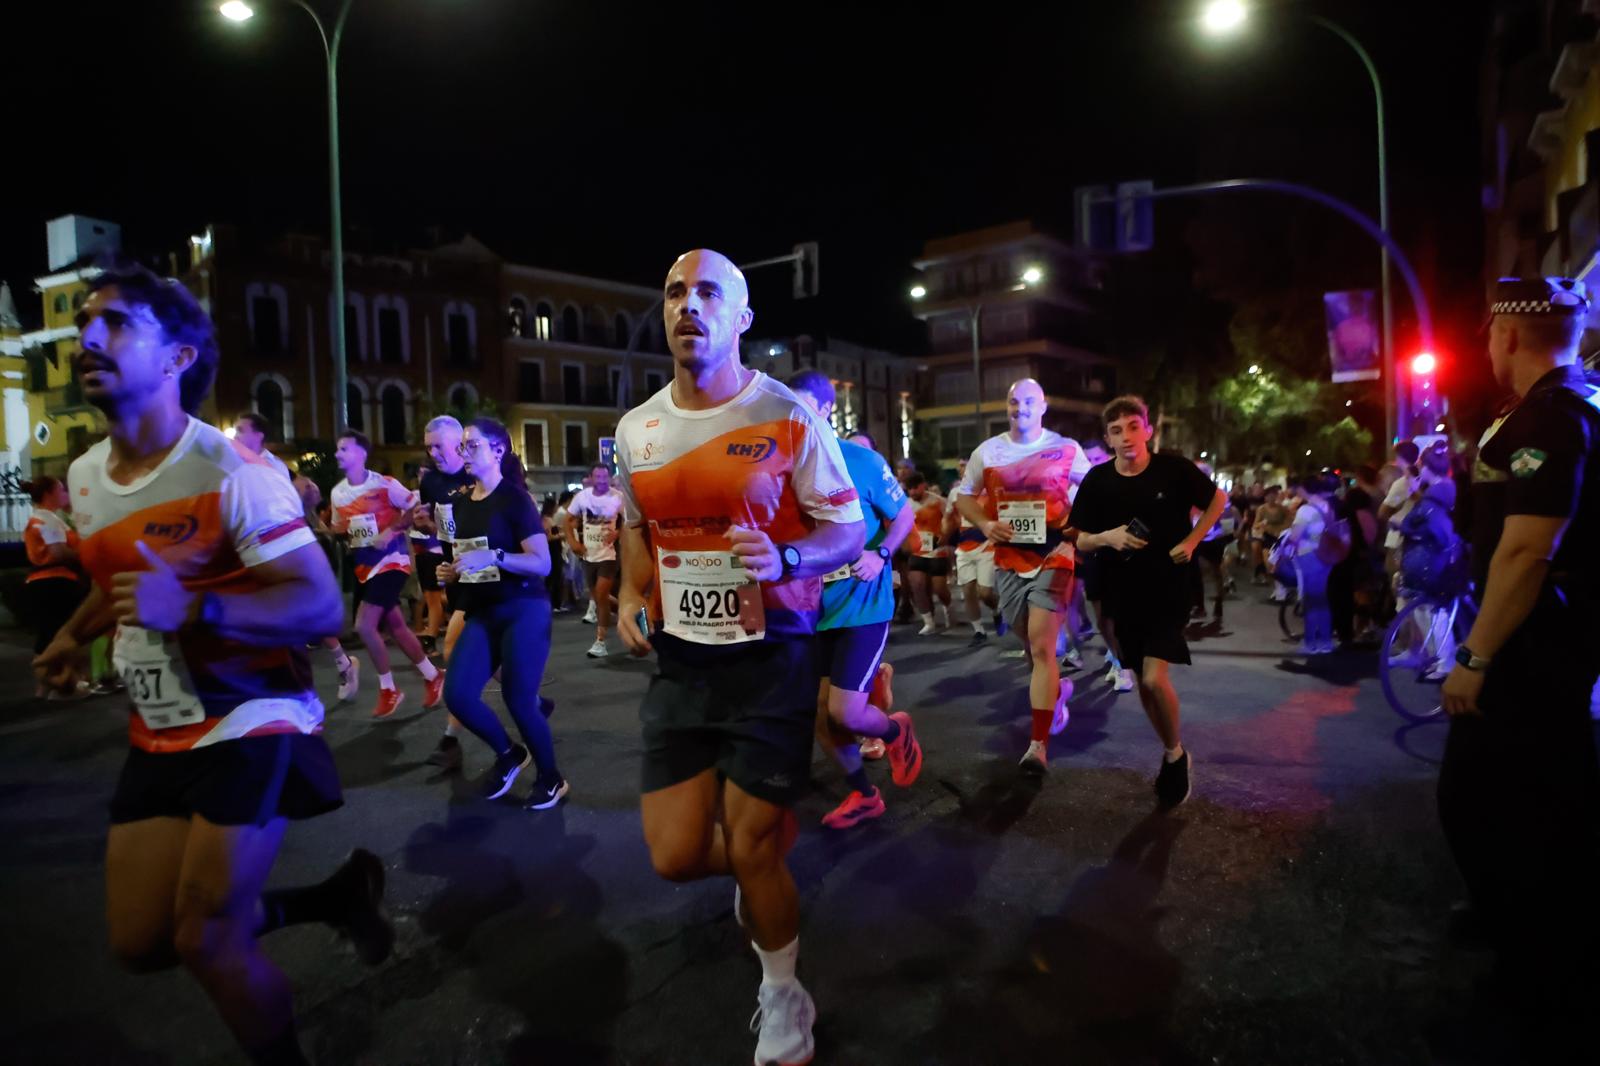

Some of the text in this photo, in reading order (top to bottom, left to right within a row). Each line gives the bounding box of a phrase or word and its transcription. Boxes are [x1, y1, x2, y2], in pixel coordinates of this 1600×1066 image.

[726, 443, 769, 459] KH7
[143, 522, 187, 542] KH7
[680, 589, 740, 619] 4920
